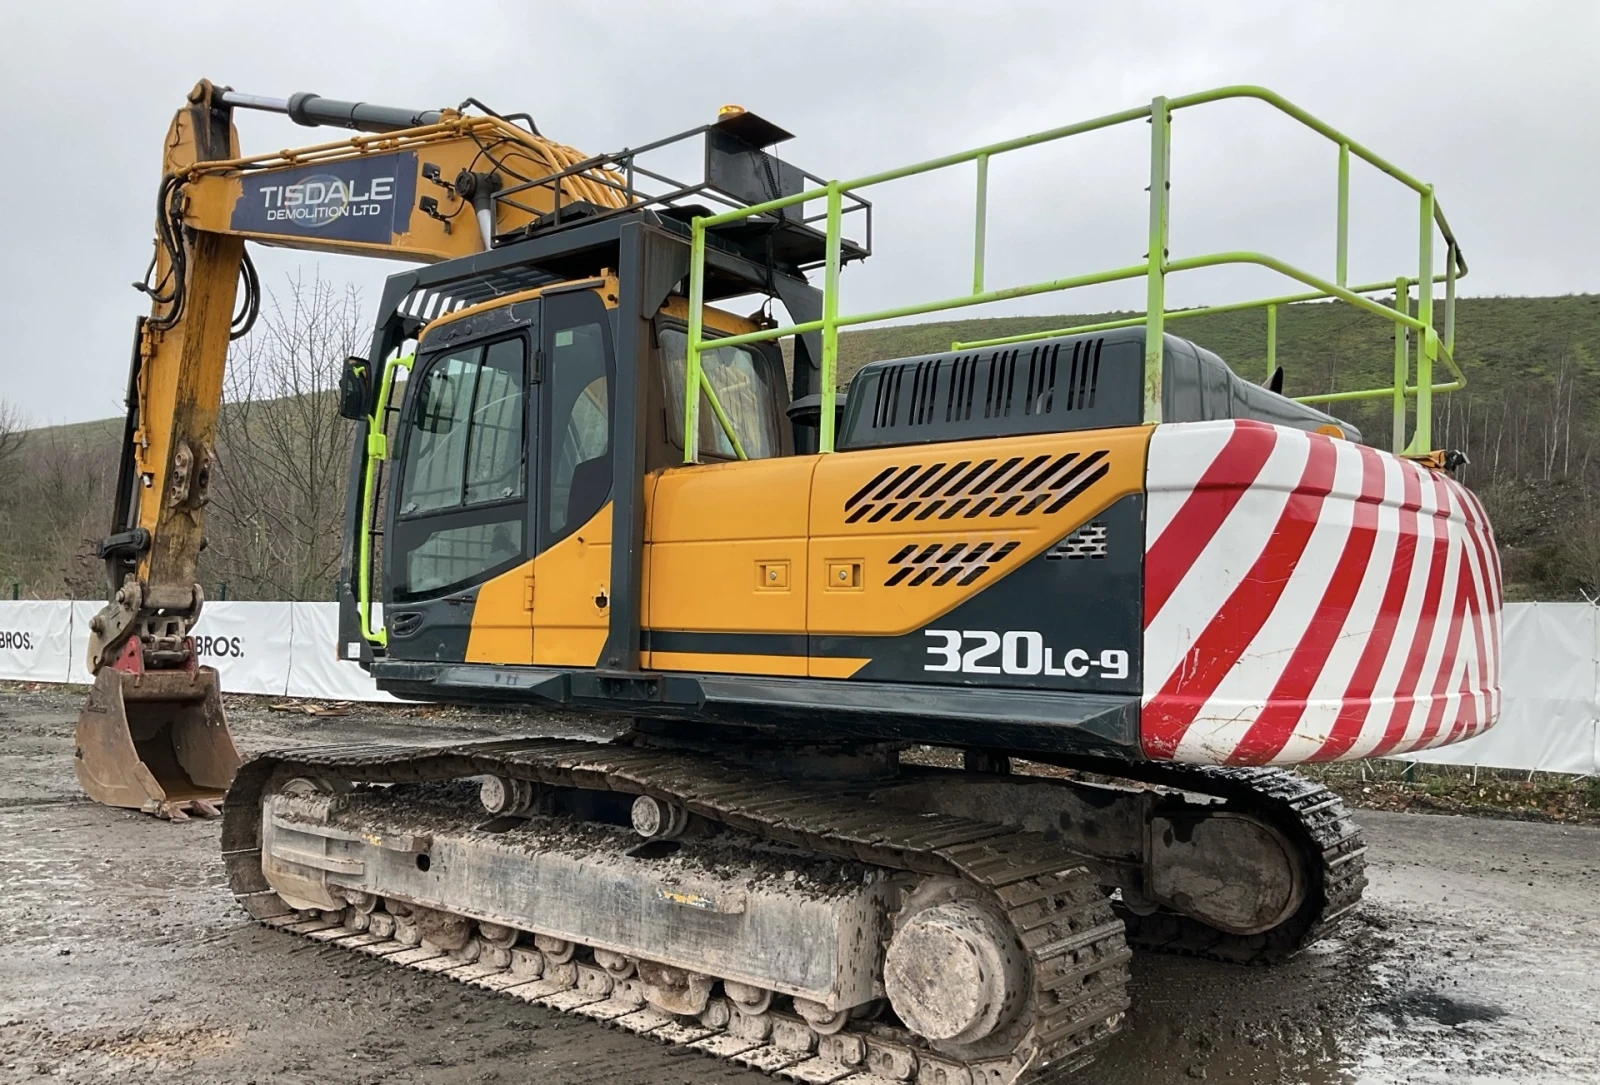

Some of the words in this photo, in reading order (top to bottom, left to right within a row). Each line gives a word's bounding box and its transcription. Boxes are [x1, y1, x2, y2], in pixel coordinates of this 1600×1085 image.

[260, 177, 395, 208] TISDALE
[267, 205, 350, 221] DEMOLITION
[352, 203, 381, 217] LTD
